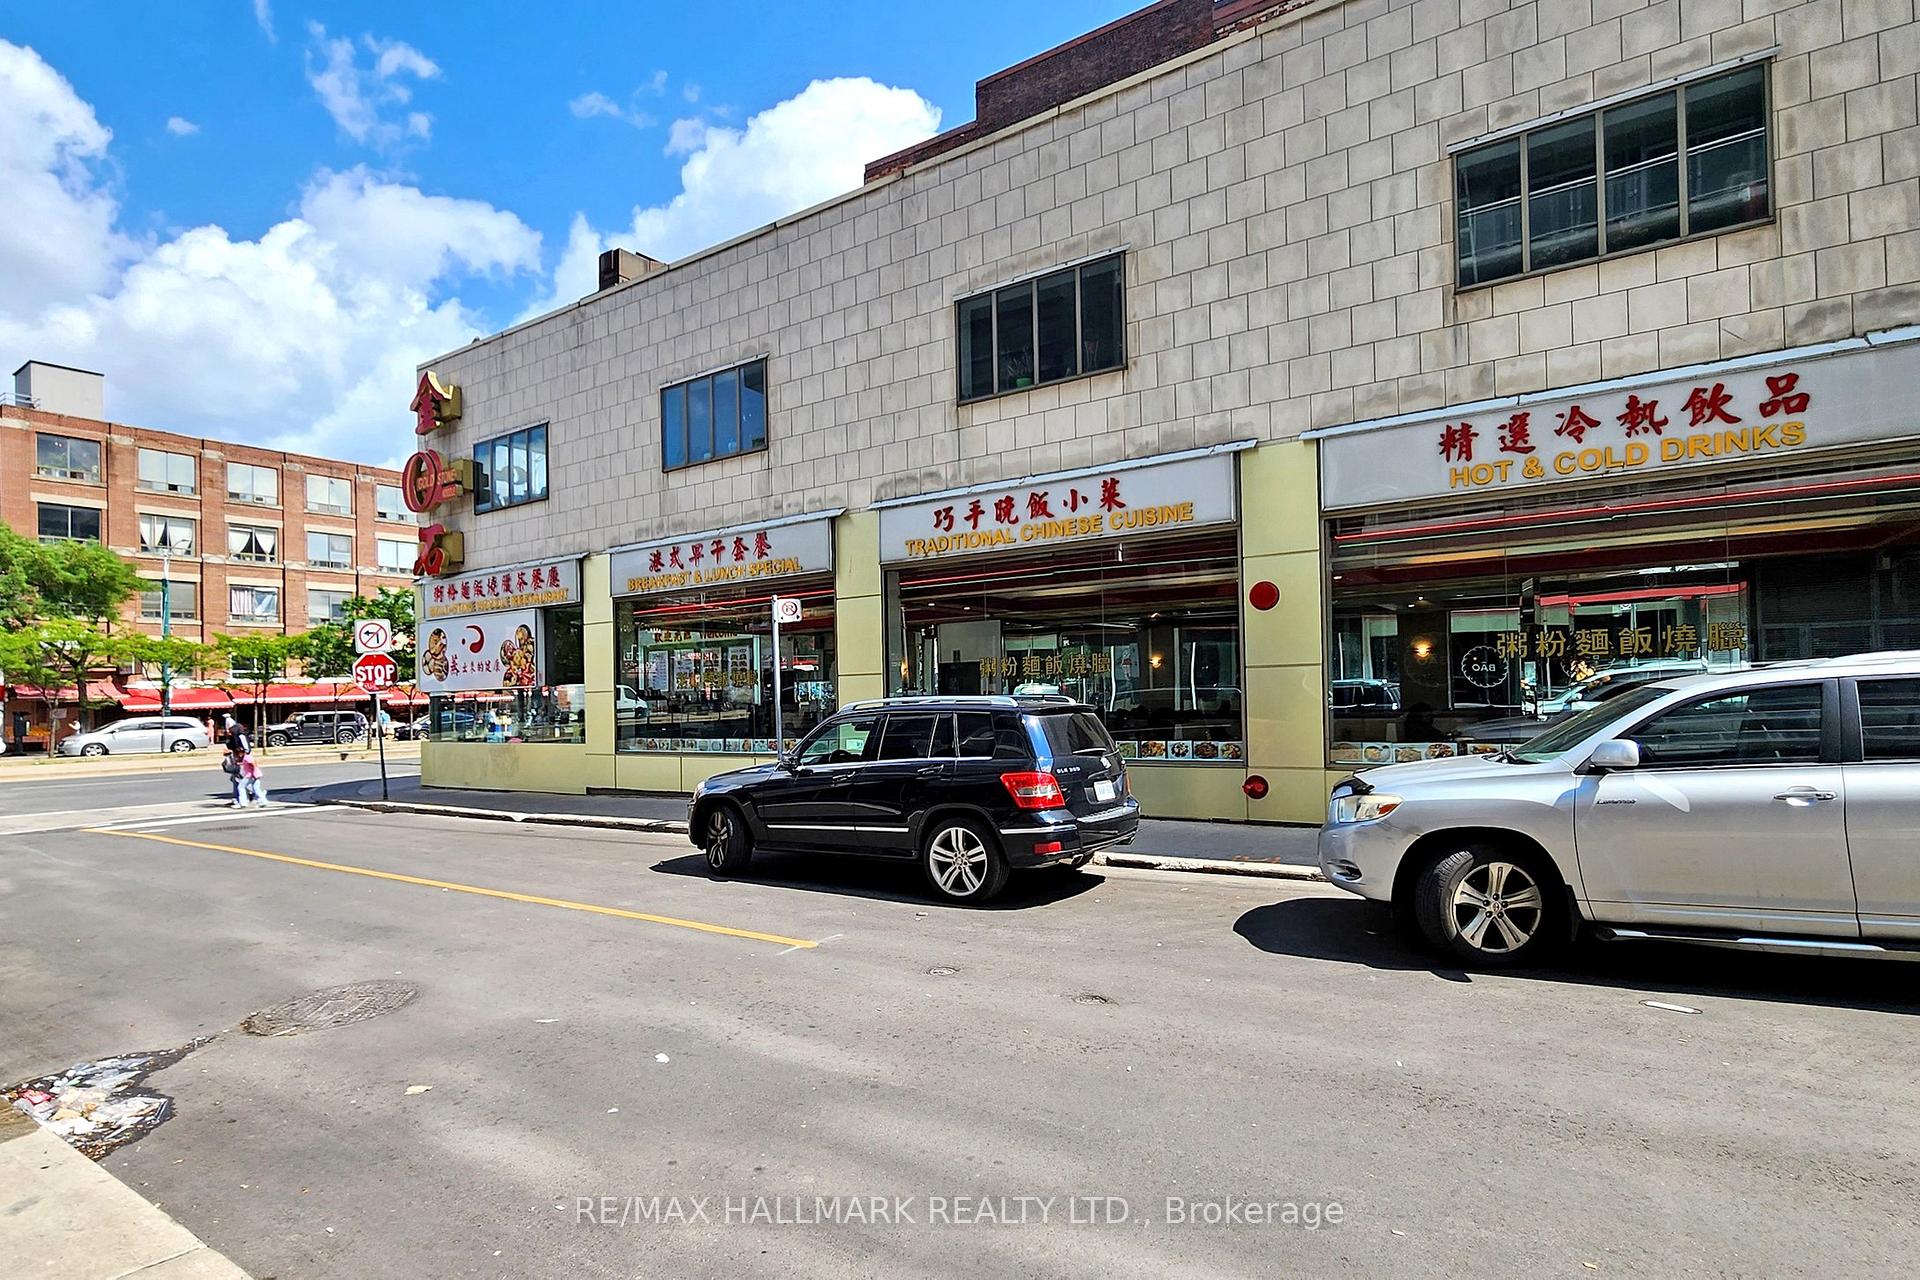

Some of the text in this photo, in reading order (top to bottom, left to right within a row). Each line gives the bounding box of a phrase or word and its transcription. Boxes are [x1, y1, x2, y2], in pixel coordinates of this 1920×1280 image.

[1438, 372, 1811, 463] 精選冷熱飲品
[1449, 421, 1807, 488] HOT & COLD DRINKS
[933, 477, 1126, 532] 巧手晚飯小菜
[905, 501, 1194, 557] TRADITIONAL CHINESE CUISINE
[648, 530, 772, 573] 港式早午套餐
[627, 557, 803, 592] BREAKFAST & LUNCH SPECIAL
[1496, 622, 1746, 659] 粥粉麵飯燒臘
[356, 664, 395, 682] STOP
[979, 653, 1111, 679] 粥粉麵飯燒臘
